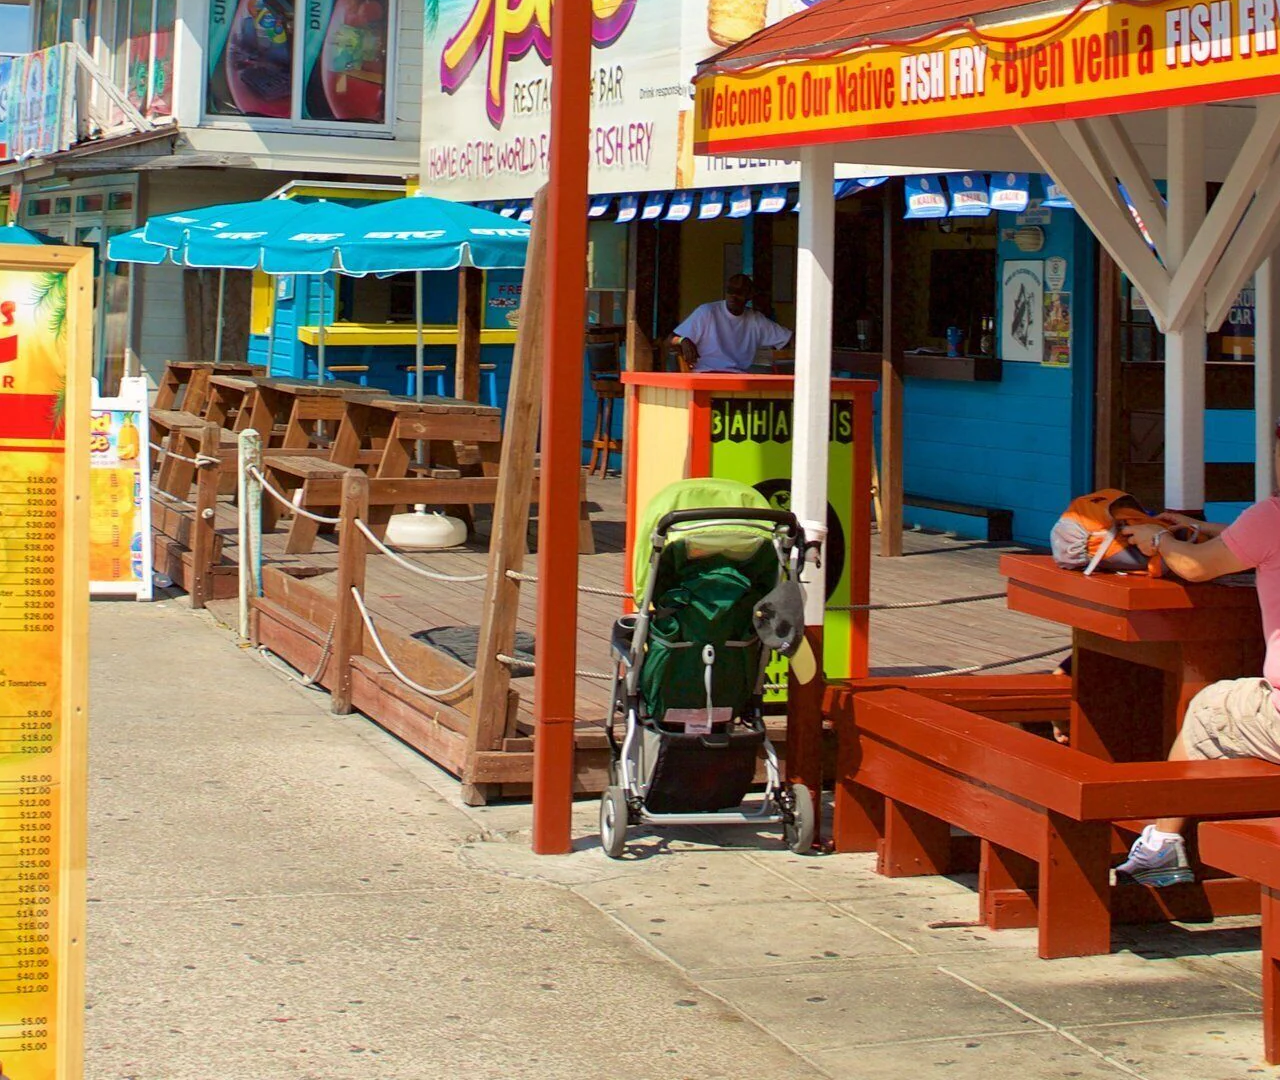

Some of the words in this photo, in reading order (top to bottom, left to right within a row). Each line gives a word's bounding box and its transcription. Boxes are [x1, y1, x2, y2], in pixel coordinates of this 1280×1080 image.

[1004, 39, 1065, 98] Byen
[1071, 18, 1130, 85] veni
[1137, 23, 1155, 76] a
[1165, 0, 1233, 69] FISH
[598, 65, 624, 103] BAR
[700, 83, 771, 130] Welcome
[777, 74, 796, 122] To
[801, 71, 832, 118] Our
[836, 61, 895, 115] Native
[900, 50, 946, 106] FISH
[949, 44, 989, 100] FRY
[595, 124, 625, 166] FISH
[627, 121, 655, 165] FRY
[712, 409, 852, 437] BAHAS
[20, 811, 51, 819] $12.00
